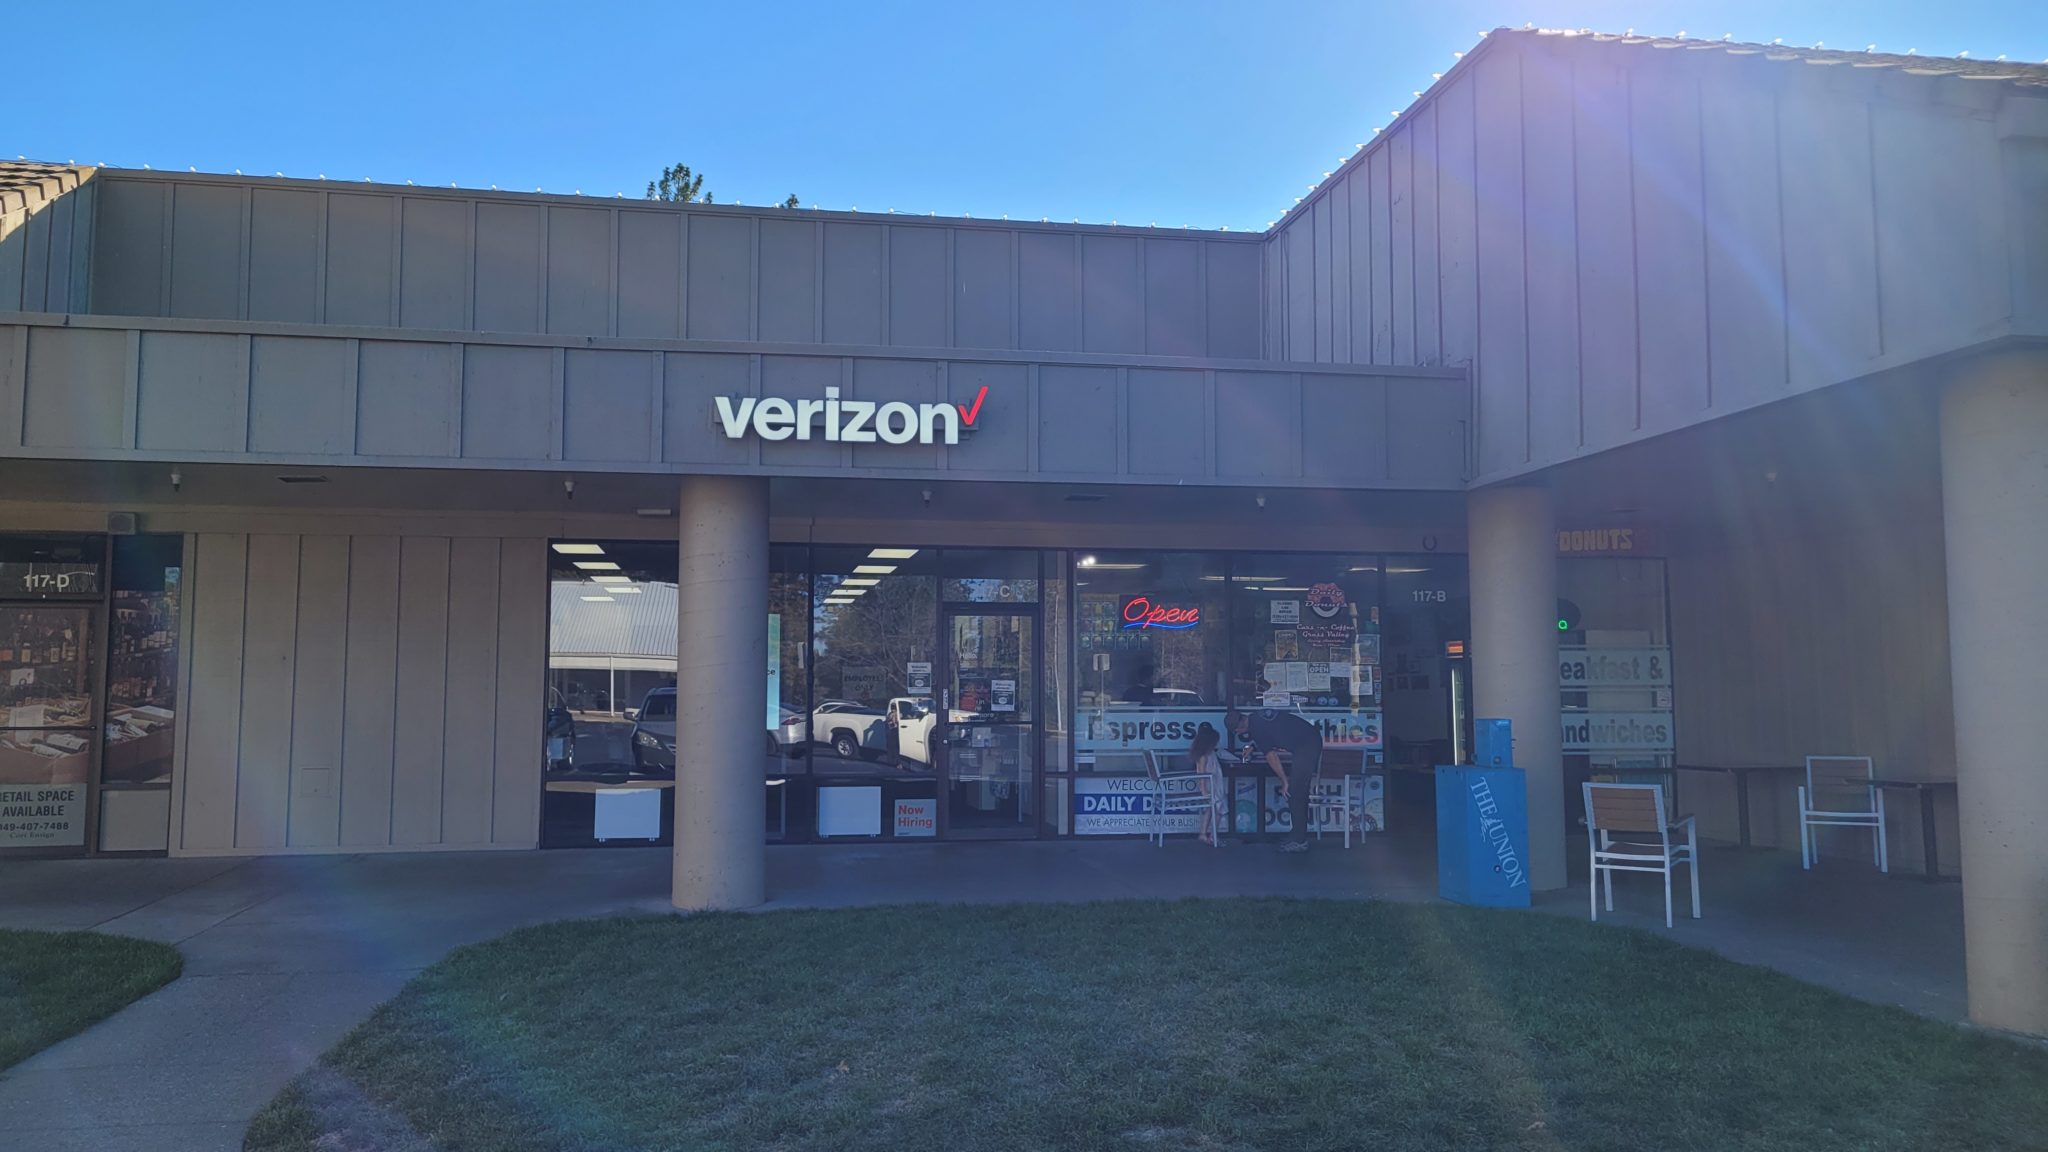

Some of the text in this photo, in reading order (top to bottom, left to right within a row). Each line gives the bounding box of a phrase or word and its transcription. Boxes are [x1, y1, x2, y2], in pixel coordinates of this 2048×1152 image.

[714, 386, 958, 445] verizon
[1559, 529, 1633, 552] DONUTS
[23, 574, 70, 588] 117-D
[1310, 588, 1342, 597] Daily
[1411, 589, 1447, 602] 117-B
[1304, 599, 1348, 608] Donuts
[1123, 597, 1200, 628] Open
[1649, 655, 1664, 681] &
[1561, 717, 1668, 744] ndwiches
[1179, 779, 1197, 792] TO
[37, 790, 75, 802] SPACE
[898, 804, 924, 816] Now
[1083, 795, 1137, 812] DAILY
[2, 805, 65, 817] AVAILABLE
[898, 816, 933, 830] Hiring
[1087, 817, 1101, 828] WE
[1102, 817, 1150, 828] APPRECIATE
[1470, 775, 1528, 888] THE UNION
